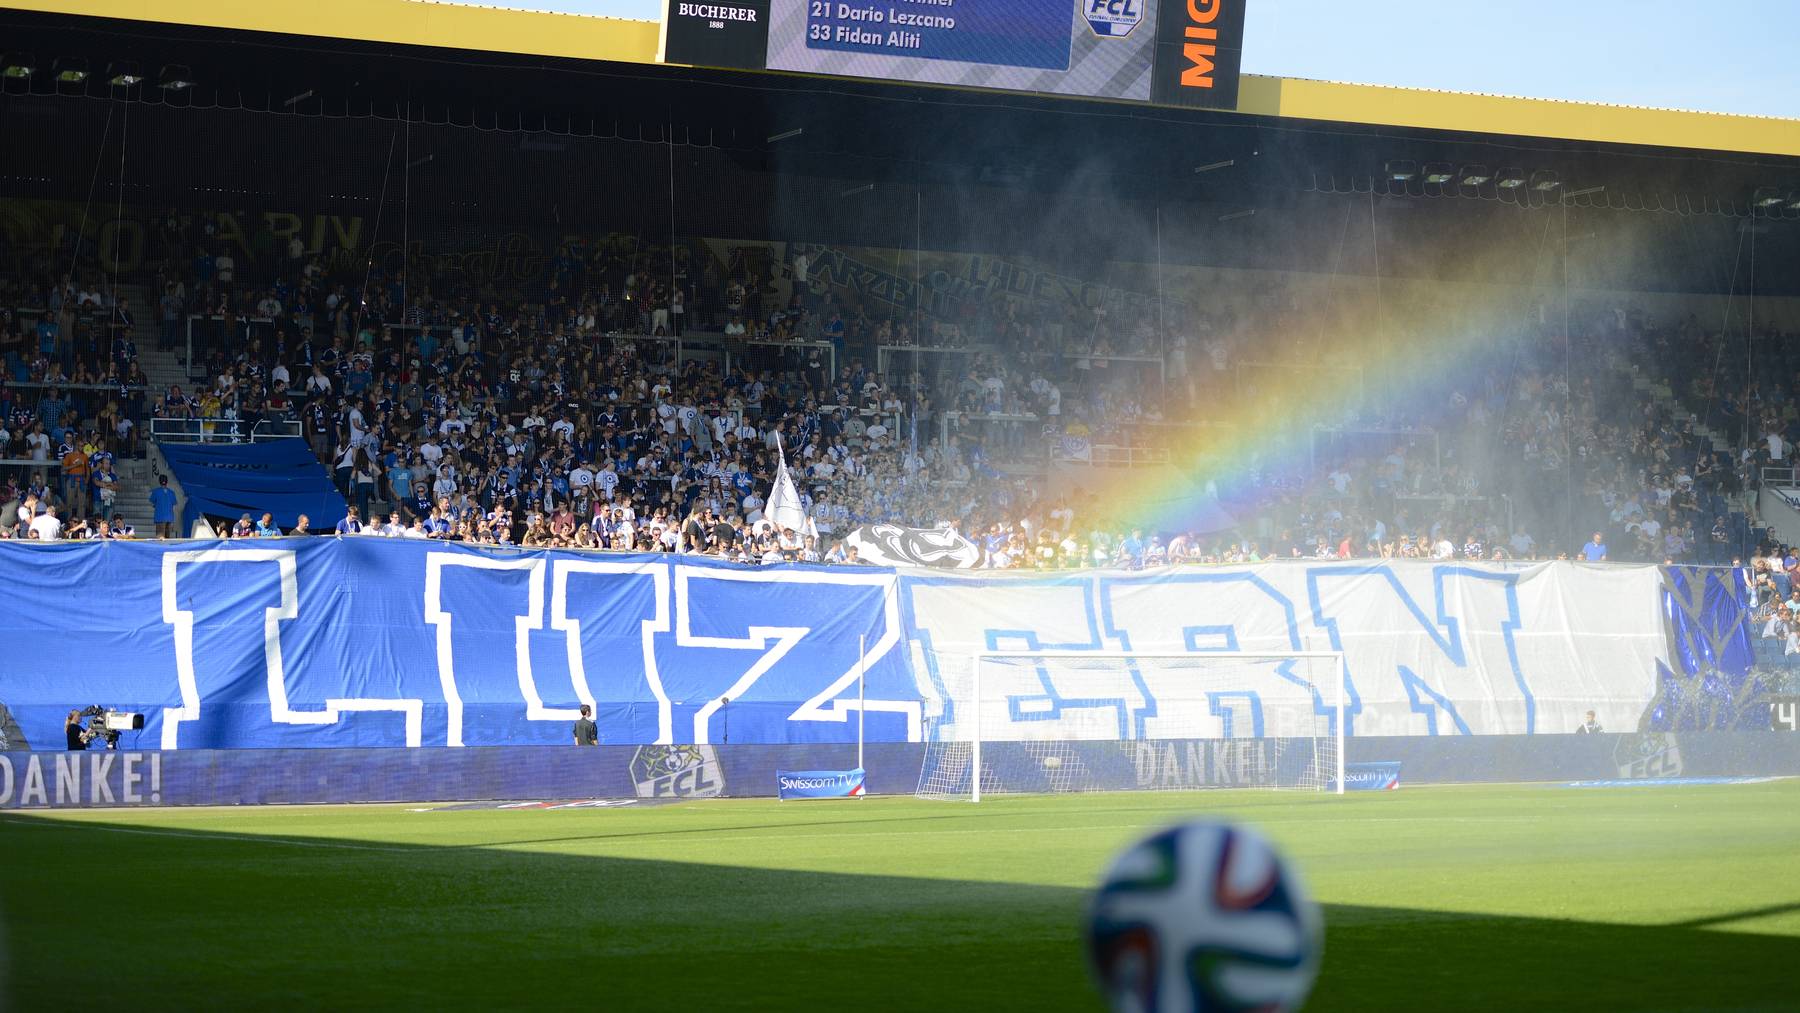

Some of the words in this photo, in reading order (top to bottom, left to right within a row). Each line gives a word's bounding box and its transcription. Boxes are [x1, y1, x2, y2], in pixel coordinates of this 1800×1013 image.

[678, 3, 757, 22] BUCHERER
[811, 2, 830, 17] 21
[838, 4, 884, 22] Dario
[889, 9, 956, 29] Lezcano
[709, 21, 724, 29] 1888
[810, 25, 831, 40] 33
[836, 26, 882, 45] Fidan
[887, 31, 921, 49] Aliti
[1135, 741, 1266, 786] DANKE!
[652, 766, 715, 797] FCL
[780, 776, 835, 790] Swisscom
